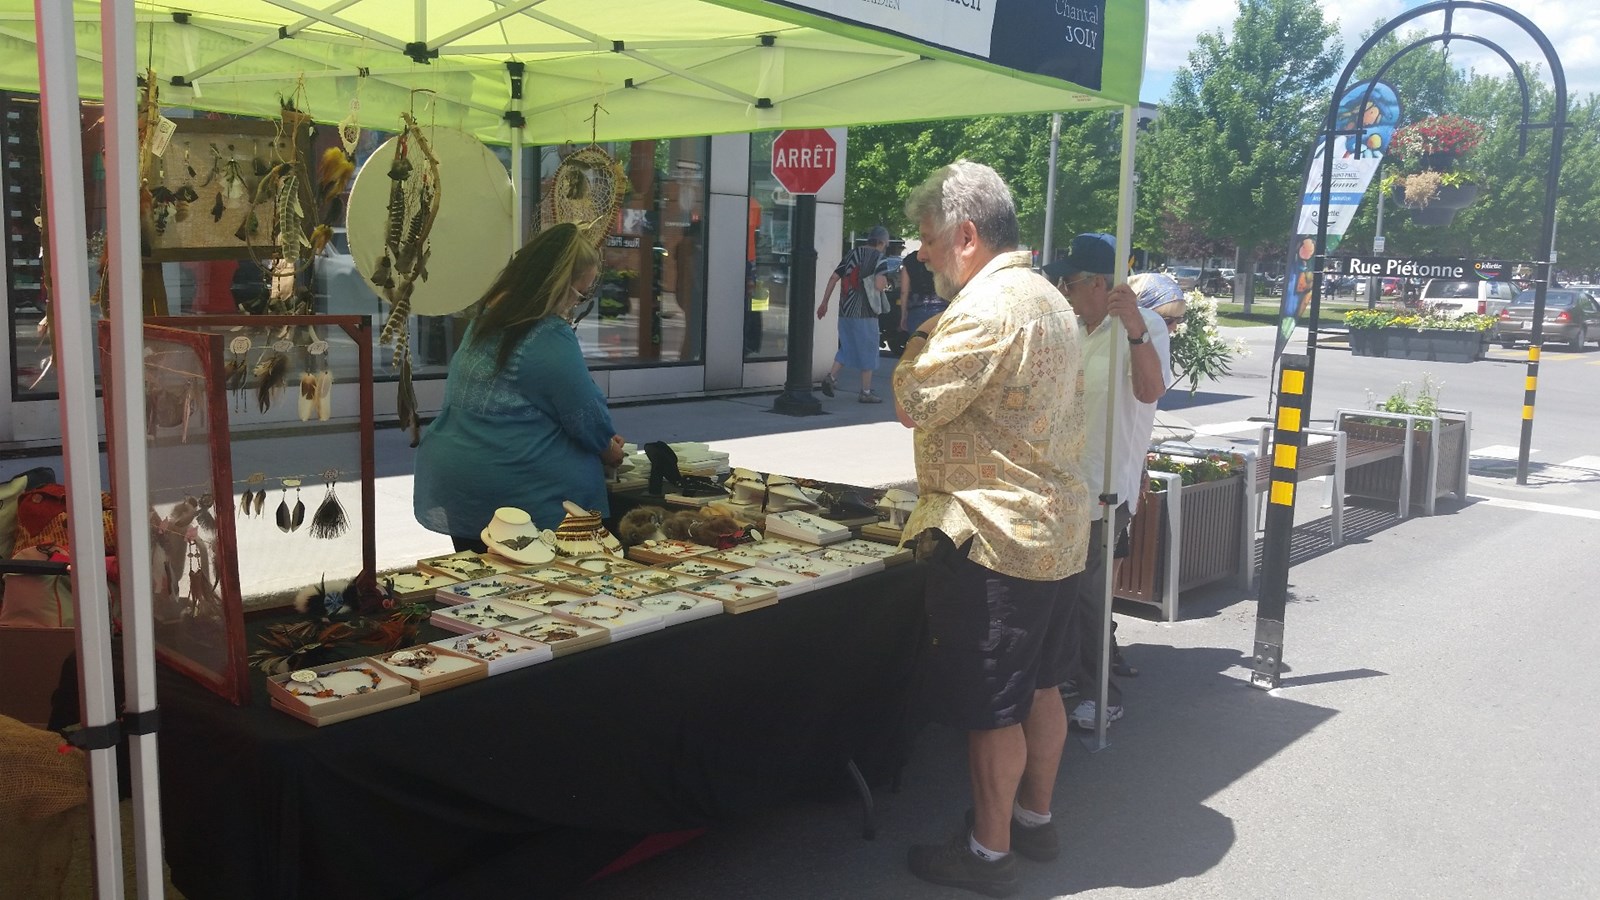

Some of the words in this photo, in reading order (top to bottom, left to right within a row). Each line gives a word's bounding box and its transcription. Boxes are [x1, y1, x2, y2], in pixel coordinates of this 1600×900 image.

[1065, 25, 1098, 50] JOLY
[775, 144, 834, 168] ARRÊT
[1349, 258, 1382, 275] Rue
[1386, 259, 1464, 279] Piétonne
